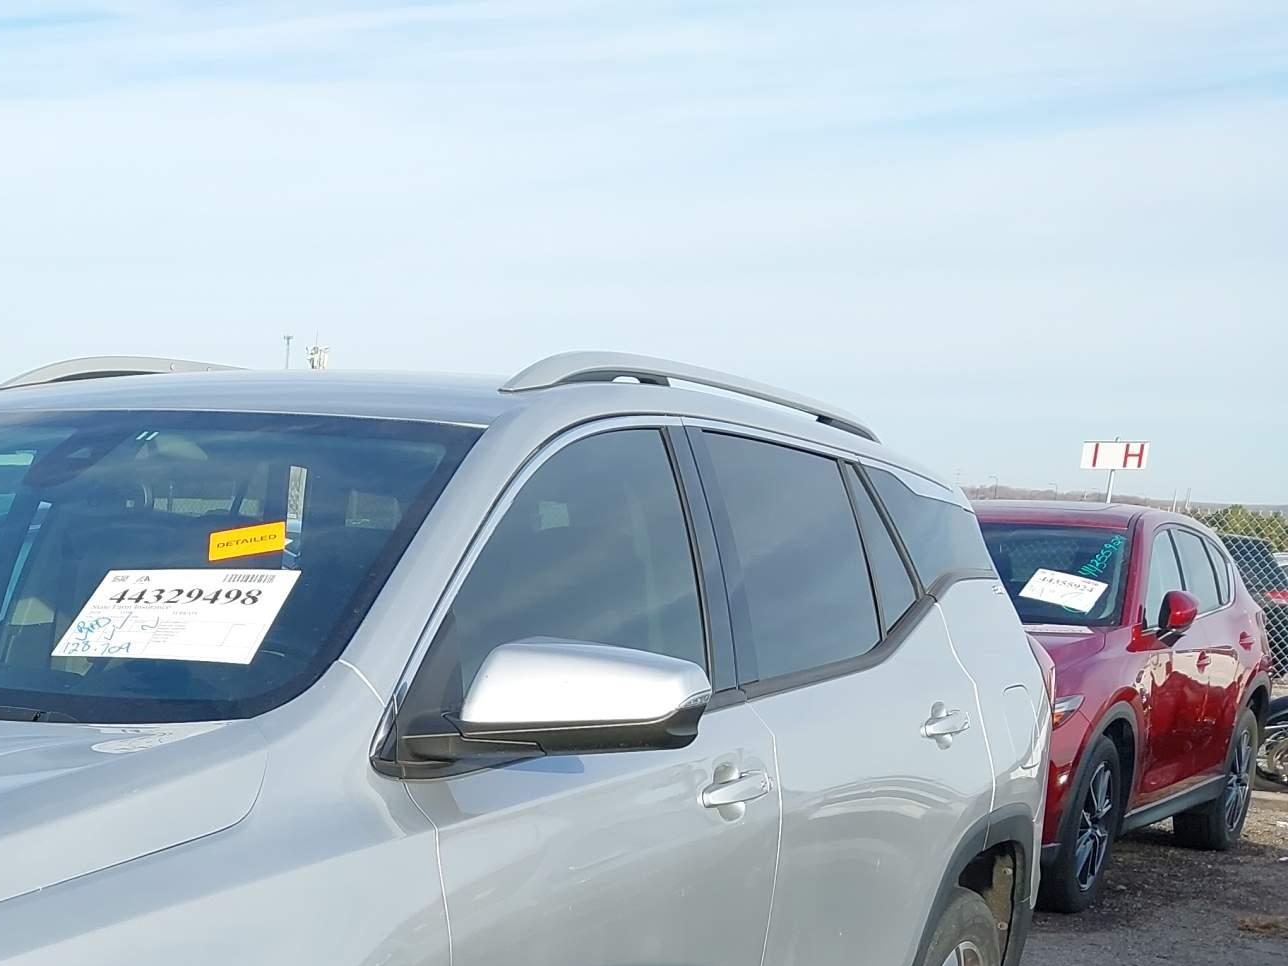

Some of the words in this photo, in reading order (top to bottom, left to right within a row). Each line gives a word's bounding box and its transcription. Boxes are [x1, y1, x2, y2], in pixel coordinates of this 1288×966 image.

[1092, 442, 1099, 467] I
[1122, 443, 1145, 468] H
[216, 534, 278, 549] DETAILED
[108, 587, 263, 606] 44329498
